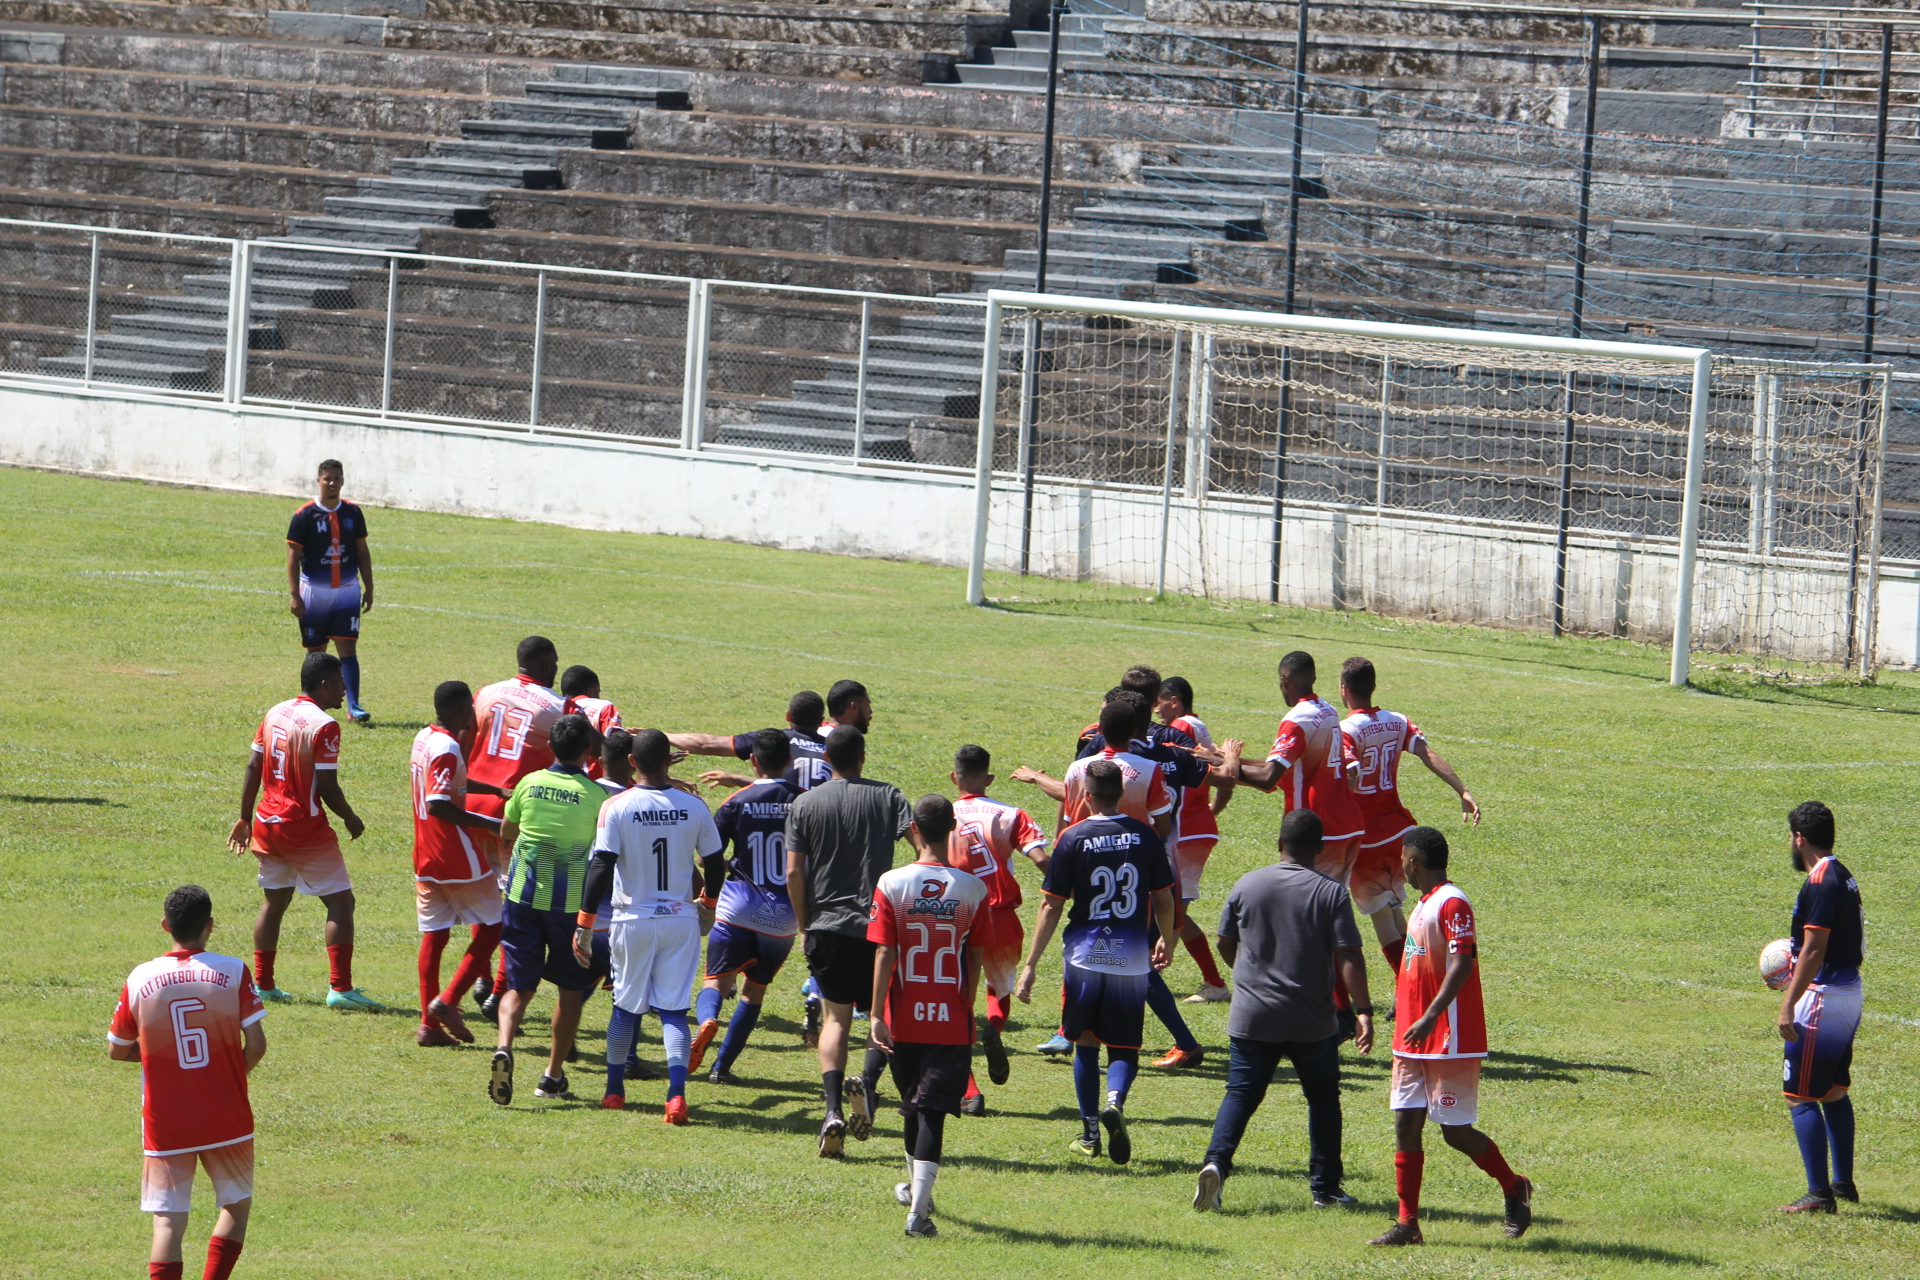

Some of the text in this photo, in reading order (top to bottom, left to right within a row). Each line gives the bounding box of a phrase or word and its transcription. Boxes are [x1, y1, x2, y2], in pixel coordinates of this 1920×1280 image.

[317, 521, 327, 532] 14
[487, 701, 534, 761] 13
[270, 725, 288, 781] 5
[1327, 726, 1341, 779] 4
[1353, 738, 1398, 794] 20
[793, 757, 832, 790] 15
[411, 762, 428, 820] 11
[528, 786, 580, 805] DIRETORIA
[632, 809, 688, 823] AMIGOS
[747, 831, 787, 886] 10
[959, 820, 998, 878] 3
[1083, 833, 1141, 852] AMIGOS
[652, 838, 668, 891] 1
[908, 899, 959, 915] JOOST
[1088, 862, 1139, 920] 23
[750, 914, 788, 931] Translog
[906, 922, 957, 984] 22
[1086, 955, 1126, 967] Translog
[1091, 938, 1123, 955] AF
[1448, 940, 1458, 954] C
[140, 969, 230, 999] CIT FUTEBOL CLUBE
[914, 1002, 949, 1021] CFA
[169, 997, 209, 1069] 6
